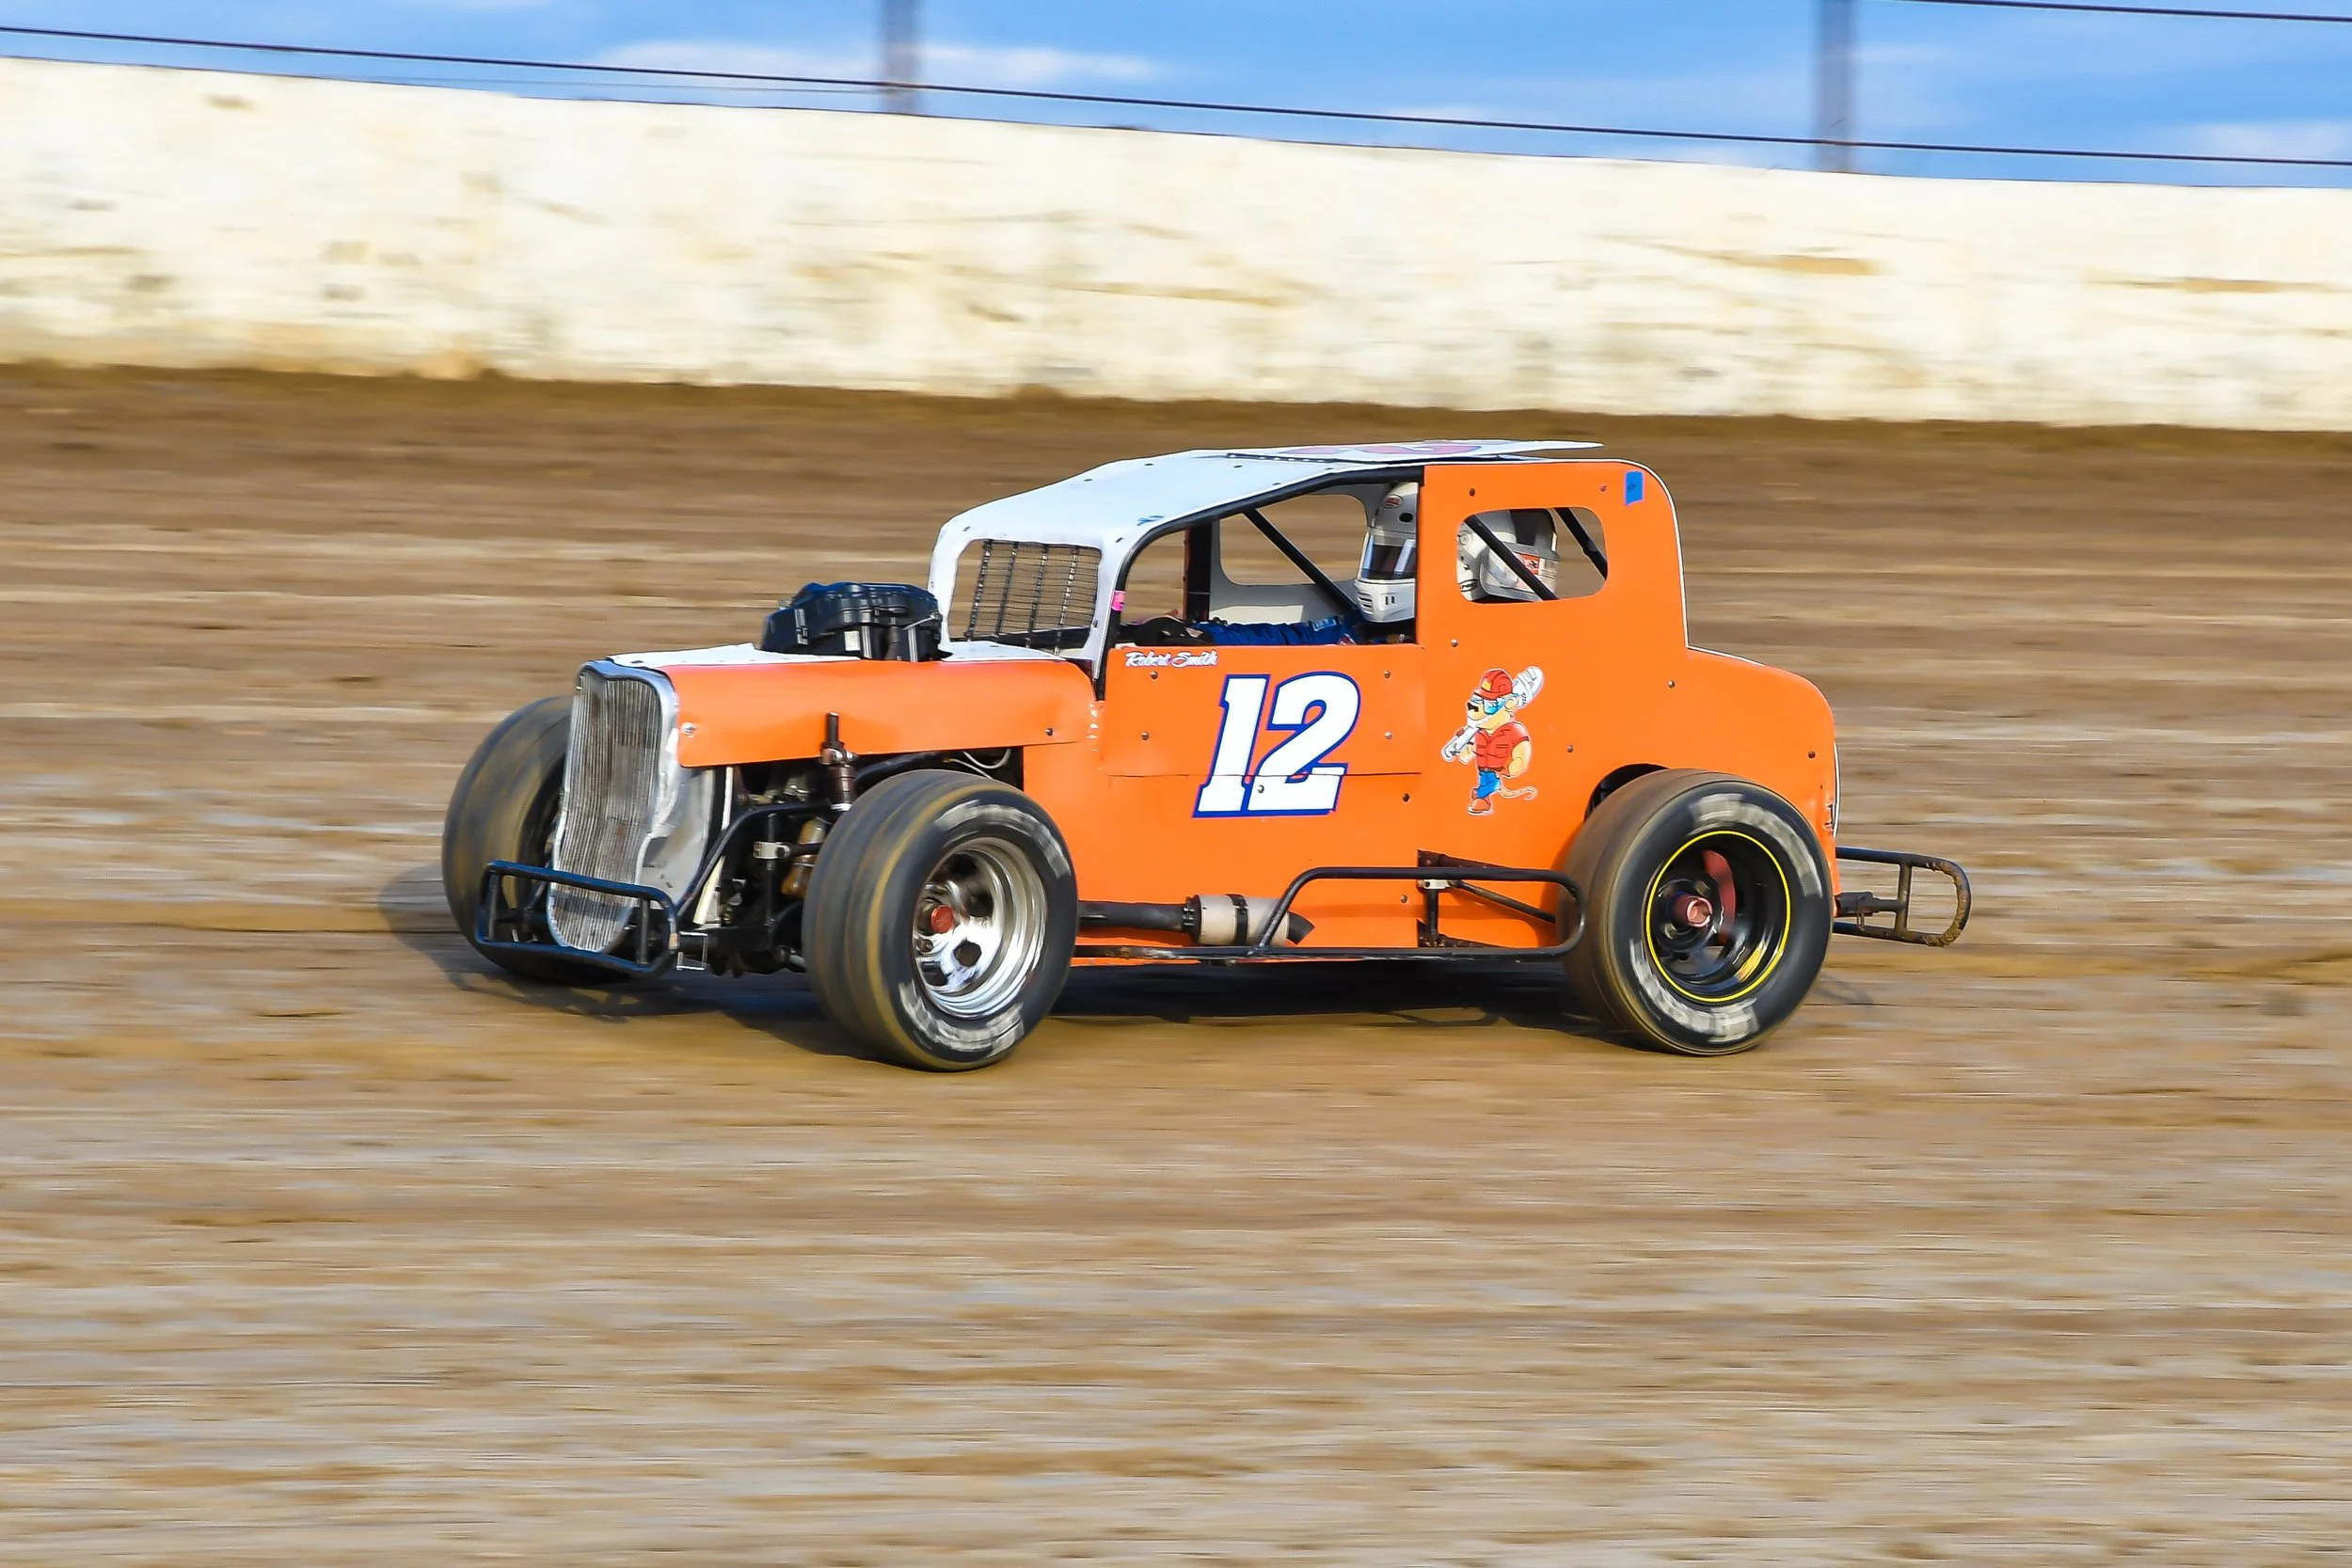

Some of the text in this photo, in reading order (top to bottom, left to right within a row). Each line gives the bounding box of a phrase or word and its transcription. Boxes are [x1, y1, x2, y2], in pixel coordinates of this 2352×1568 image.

[1125, 649, 1218, 668] Robert Smith
[1193, 671, 1360, 817] 12
